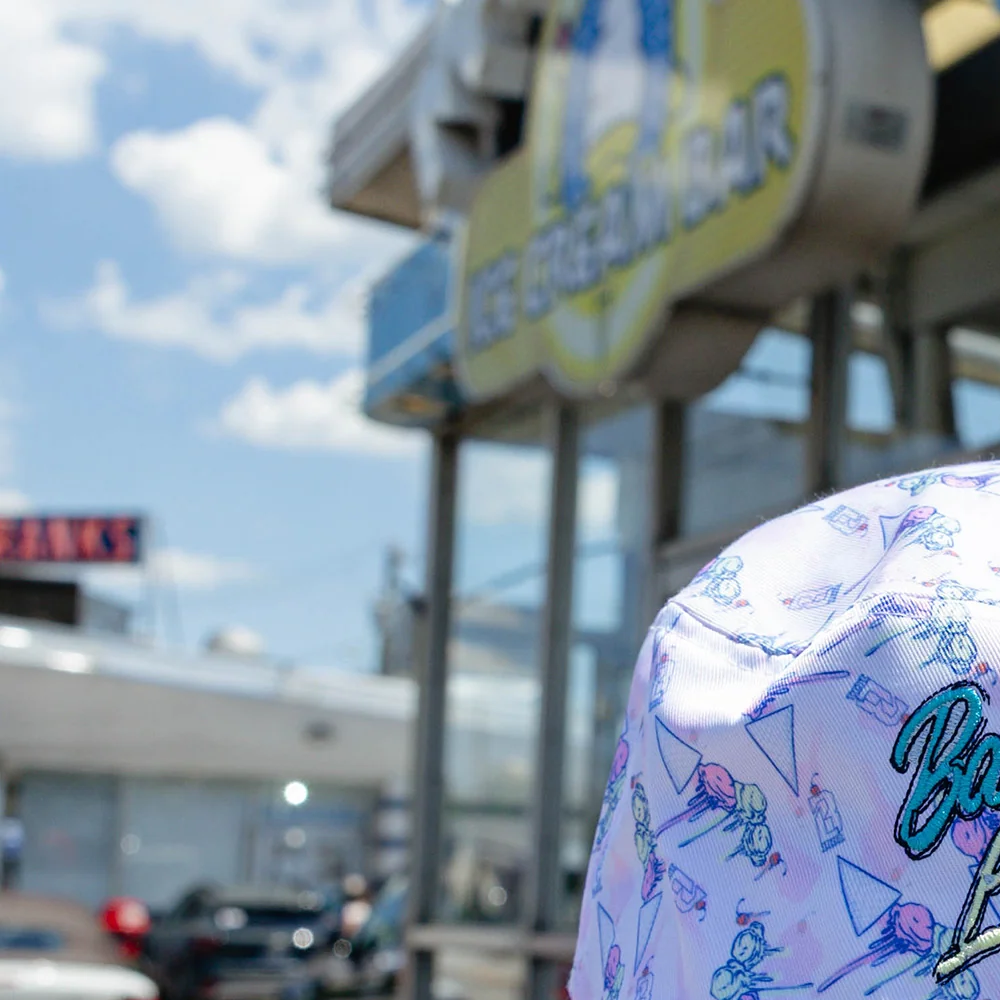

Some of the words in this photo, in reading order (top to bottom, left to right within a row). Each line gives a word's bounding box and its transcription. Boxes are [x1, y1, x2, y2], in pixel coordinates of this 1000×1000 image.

[468, 249, 520, 352] ICE
[523, 155, 672, 323] CREAM
[682, 70, 796, 233] BAR
